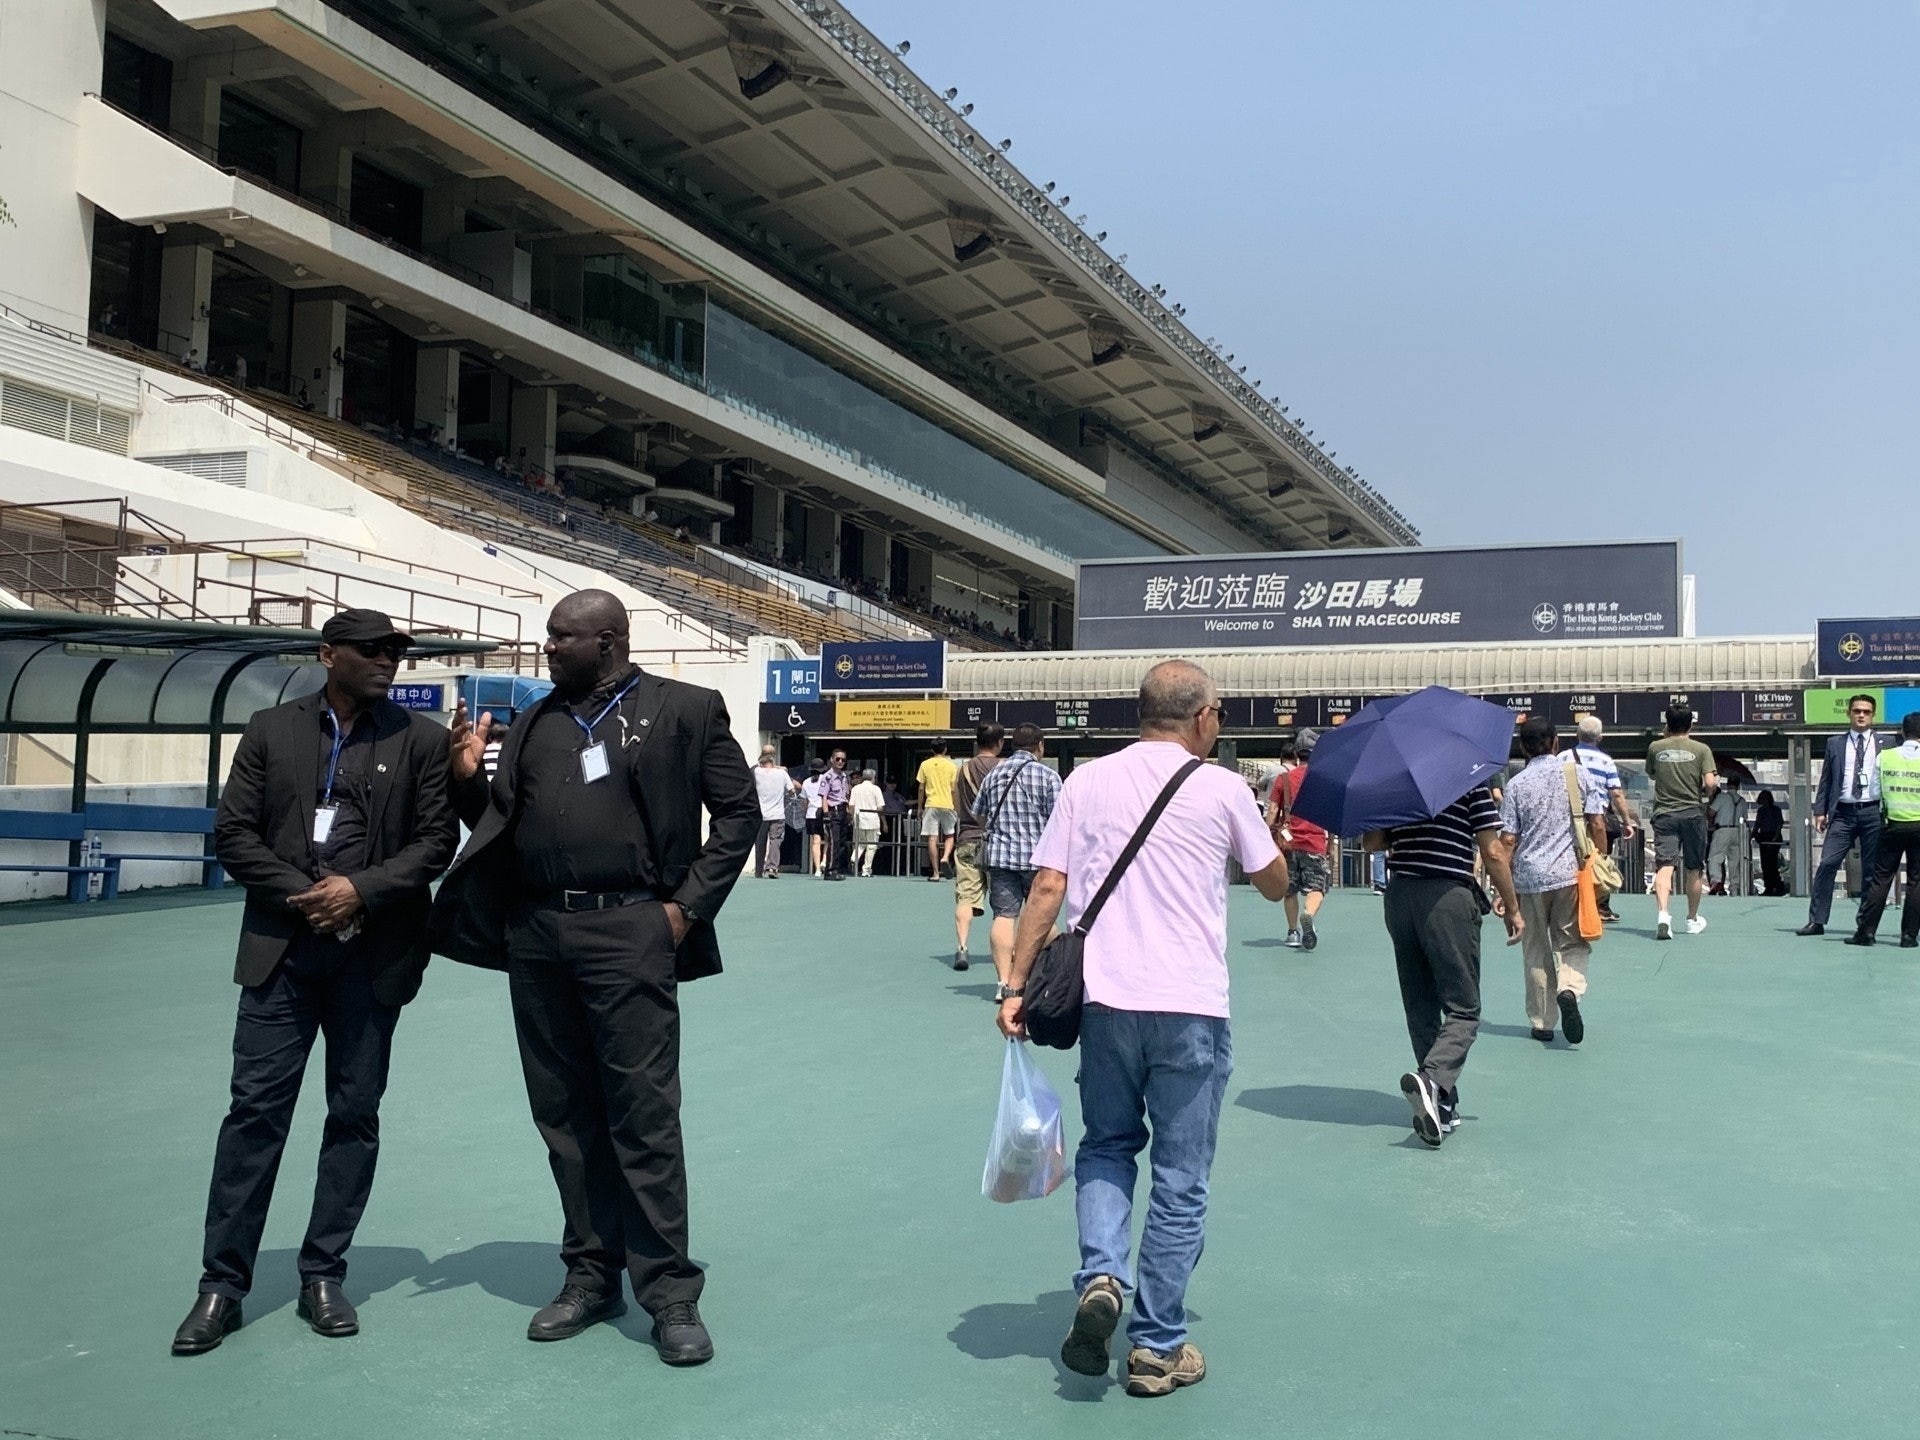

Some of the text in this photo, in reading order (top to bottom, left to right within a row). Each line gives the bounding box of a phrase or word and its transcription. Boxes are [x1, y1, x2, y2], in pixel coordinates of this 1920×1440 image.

[1142, 572, 1424, 612] 歡迎蒞臨 沙田馬場
[1562, 602, 1619, 612] 香港賽馬會
[1204, 612, 1462, 631] Welcome to SHA TIN RACECOURSE
[1562, 611, 1662, 624] The Hong Kong Jockey Club
[791, 669, 816, 685] 閘口
[772, 669, 781, 695] 1
[791, 686, 811, 695] Gate
[1274, 699, 1297, 707] 八達通
[1327, 699, 1352, 707] 八達通
[1506, 697, 1532, 706] 八達通
[1570, 695, 1596, 704] 八達通
[967, 707, 981, 715] 出口
